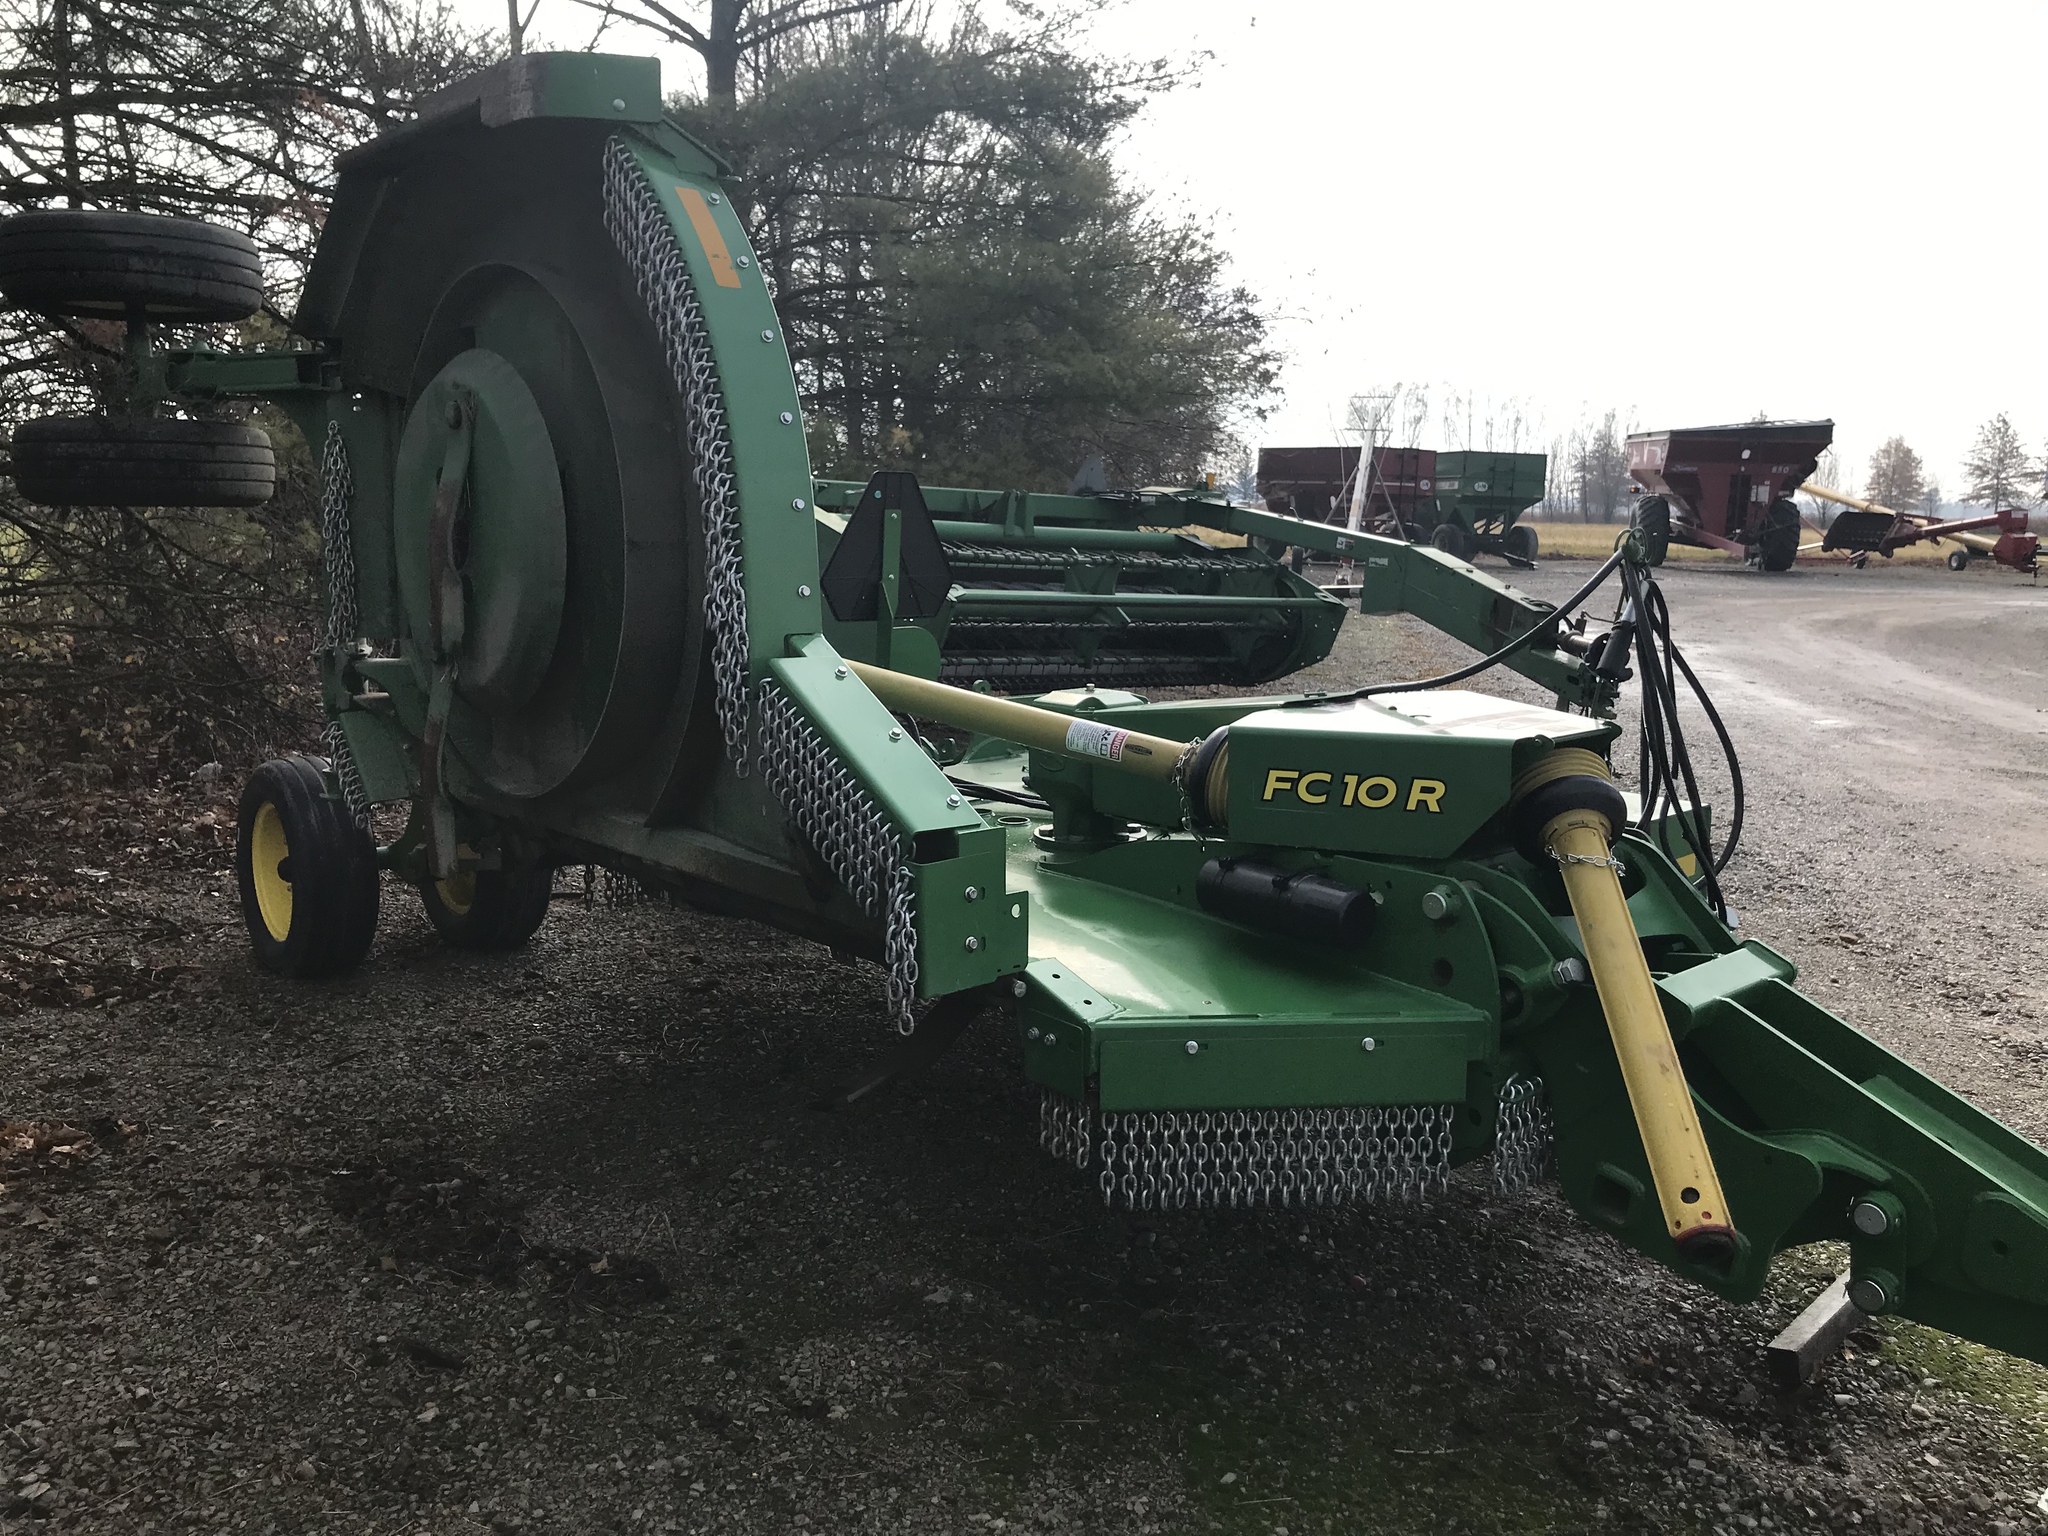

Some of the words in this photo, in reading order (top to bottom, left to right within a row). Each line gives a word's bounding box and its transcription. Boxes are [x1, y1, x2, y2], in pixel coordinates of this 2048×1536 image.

[1111, 731, 1127, 759] DANGER
[1261, 768, 1333, 805] FC
[1341, 774, 1398, 809] 10
[1404, 777, 1447, 814] R
